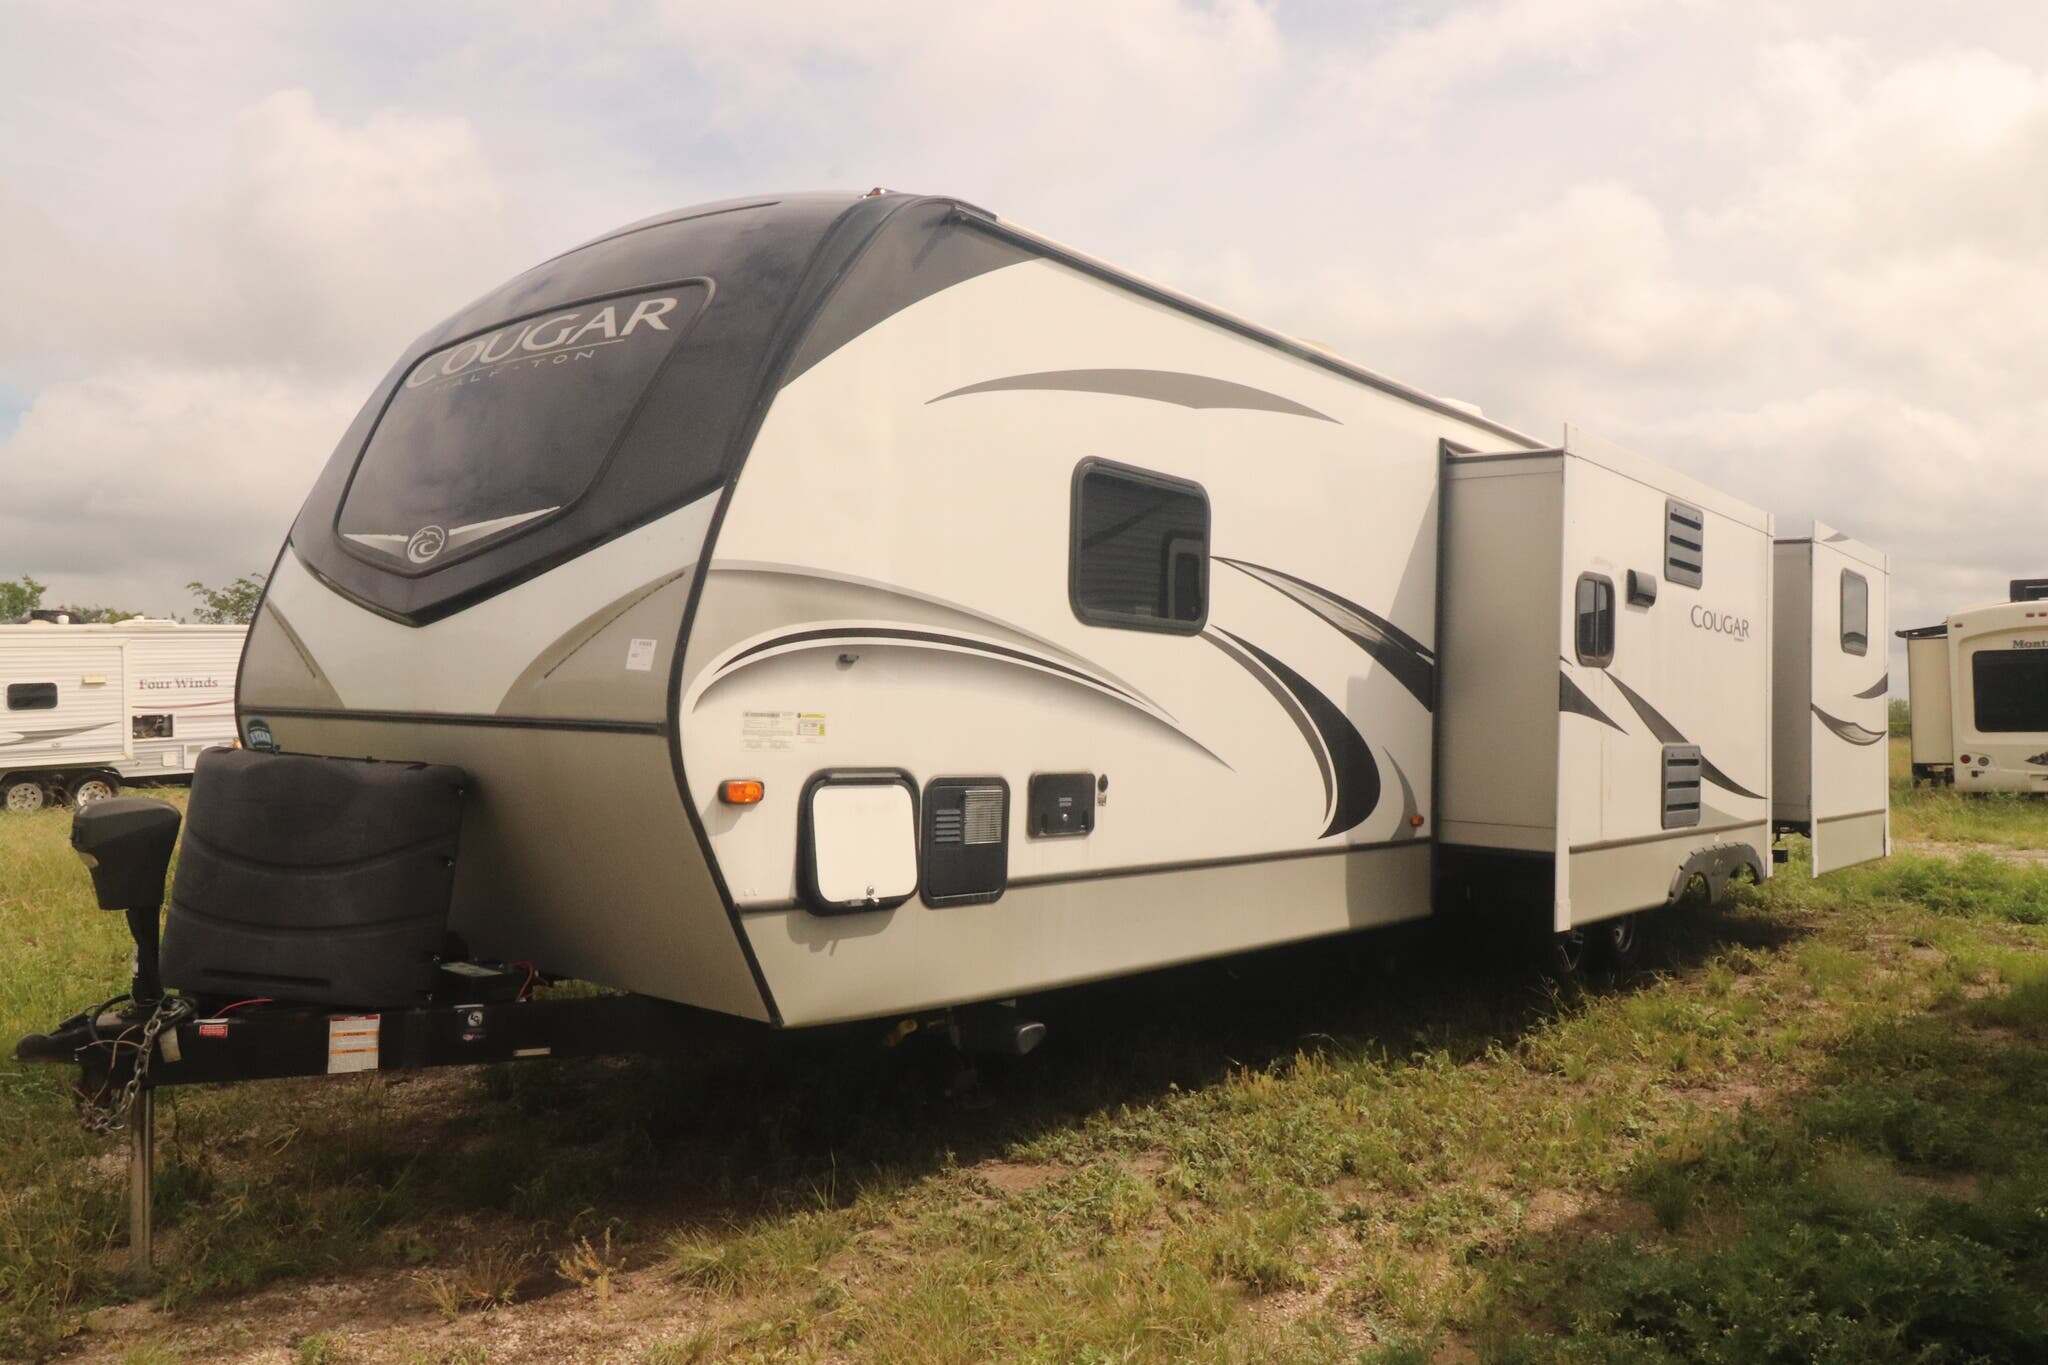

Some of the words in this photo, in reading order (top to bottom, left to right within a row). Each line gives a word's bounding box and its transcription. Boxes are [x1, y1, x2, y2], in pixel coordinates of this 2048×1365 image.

[406, 297, 679, 389] COUGAR
[1691, 604, 1750, 638] COUGAR
[139, 679, 172, 690] Four
[175, 677, 218, 689] Winds
